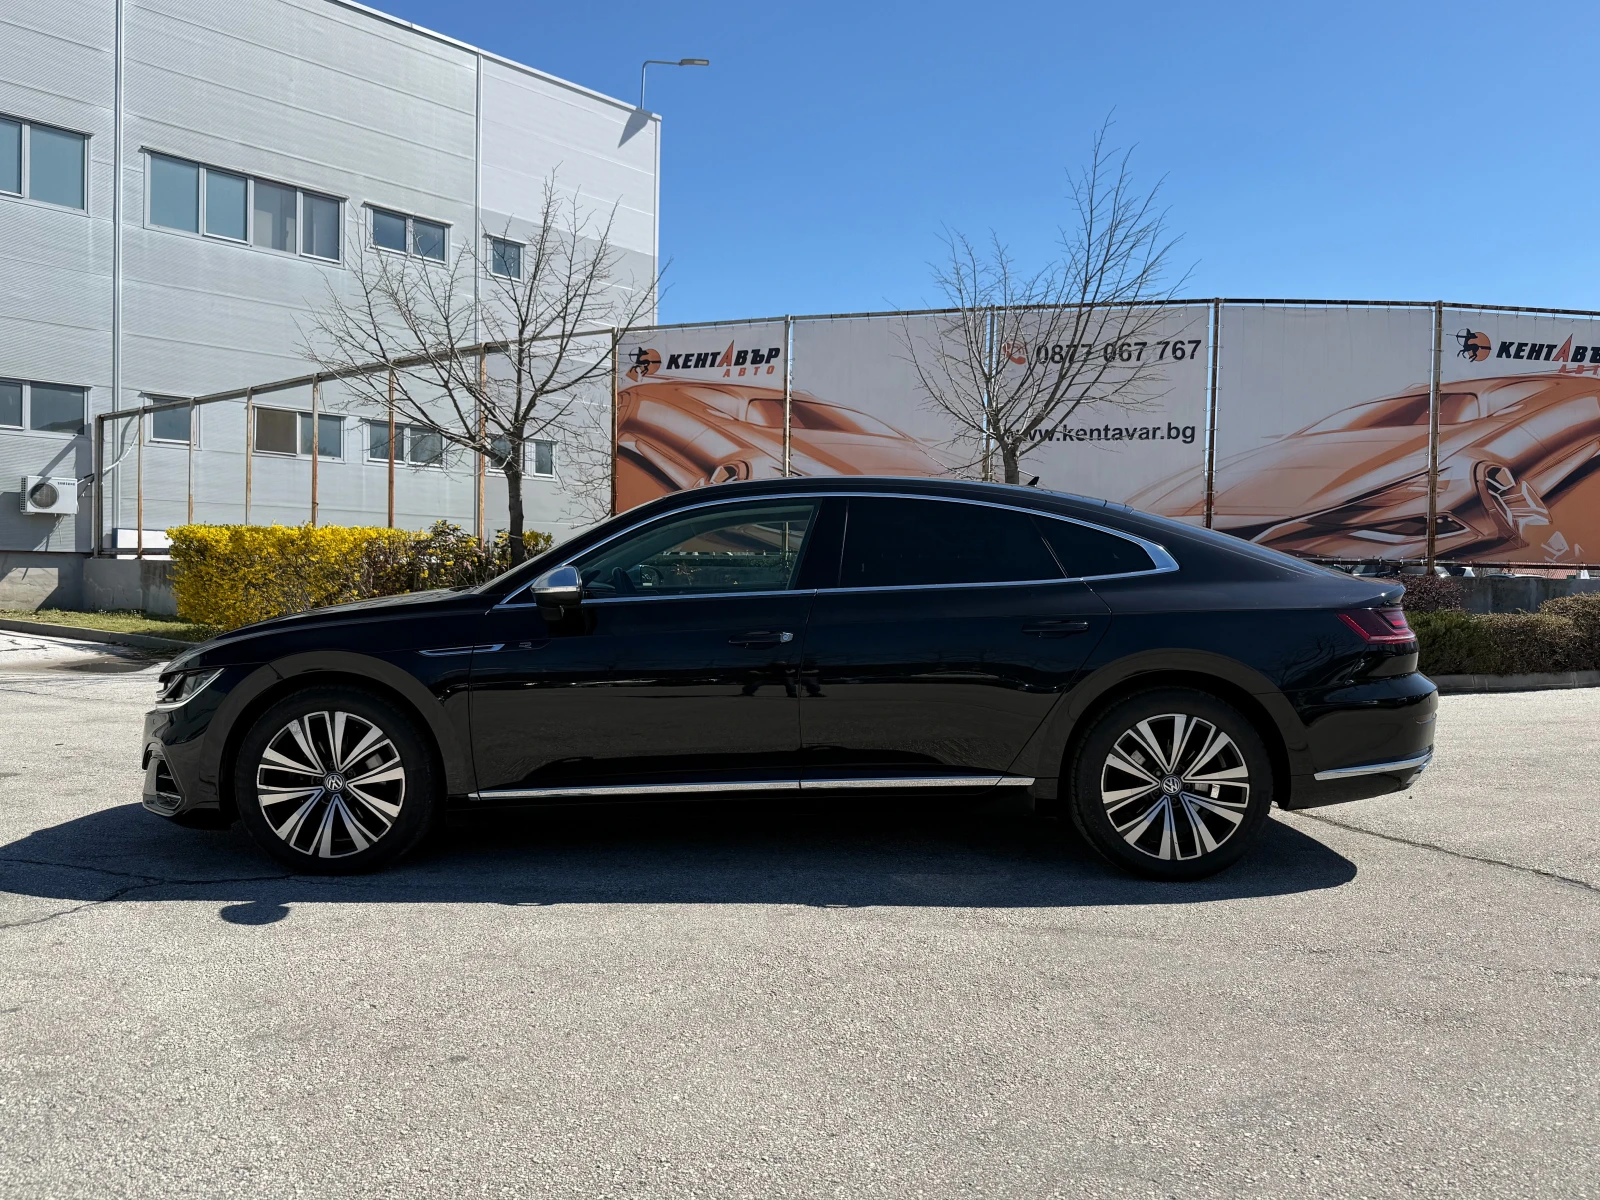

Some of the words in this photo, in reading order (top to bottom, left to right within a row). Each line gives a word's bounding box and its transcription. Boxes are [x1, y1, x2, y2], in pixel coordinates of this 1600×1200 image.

[666, 340, 780, 369] КЕНТАВЪР
[1036, 344, 1093, 364] 0877
[1103, 342, 1147, 362] 067
[1157, 340, 1201, 360] 767
[722, 365, 775, 378] АВТО
